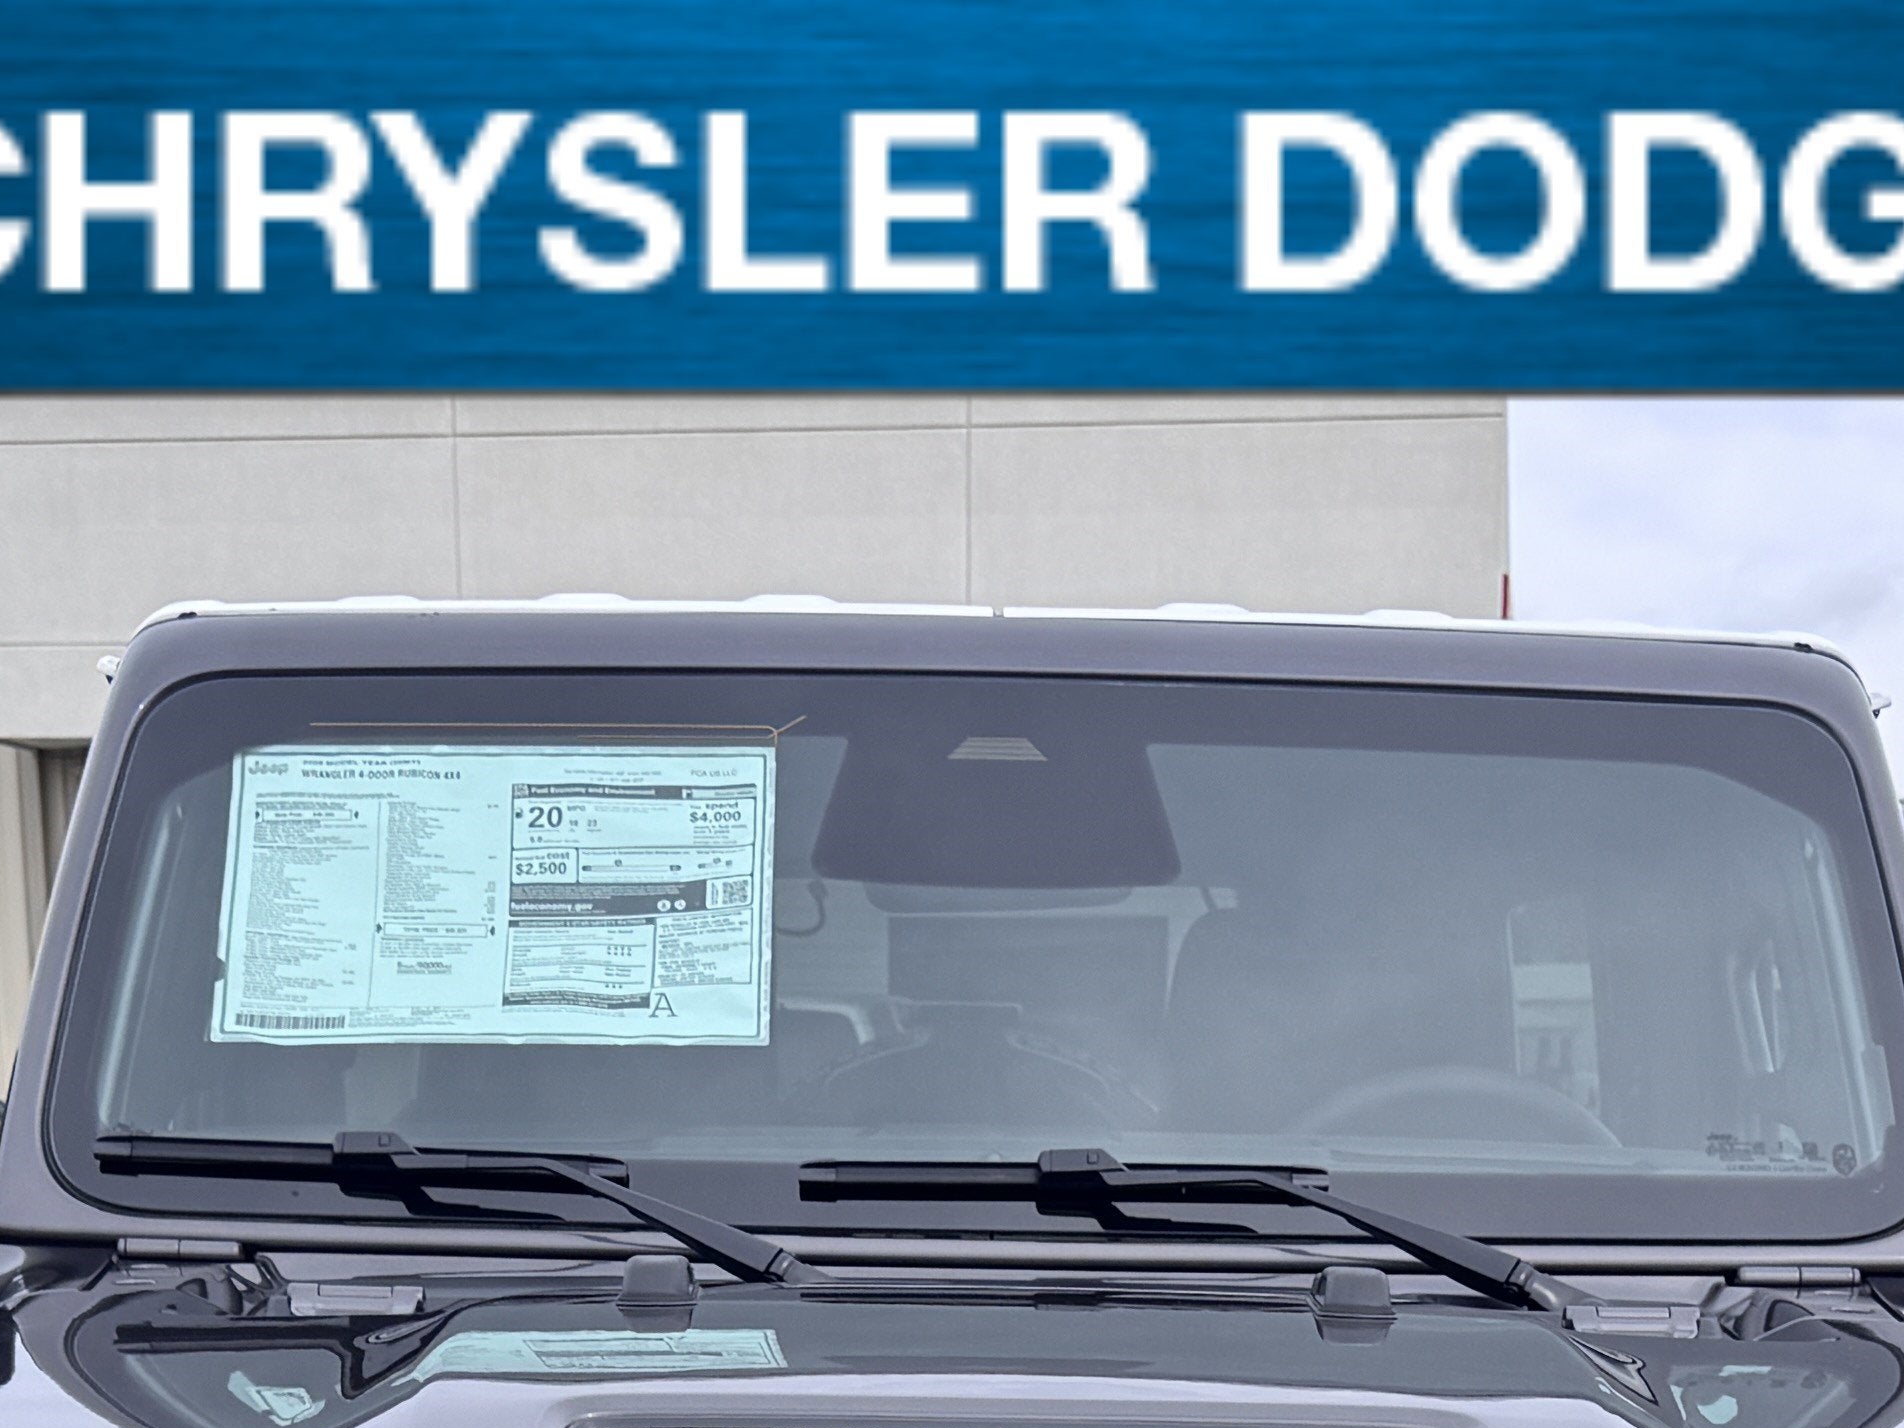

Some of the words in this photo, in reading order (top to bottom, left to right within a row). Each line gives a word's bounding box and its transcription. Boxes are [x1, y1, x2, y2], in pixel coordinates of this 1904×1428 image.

[248, 761, 290, 776] Jeep
[301, 769, 356, 779] WRANGLER
[398, 769, 441, 780] RUBICON
[550, 786, 587, 796] Economy
[528, 806, 563, 829] 20
[689, 811, 742, 824] $4,000
[515, 862, 567, 877] $2,500
[510, 902, 594, 912] fueleconomy.gov
[648, 992, 678, 1018] A
